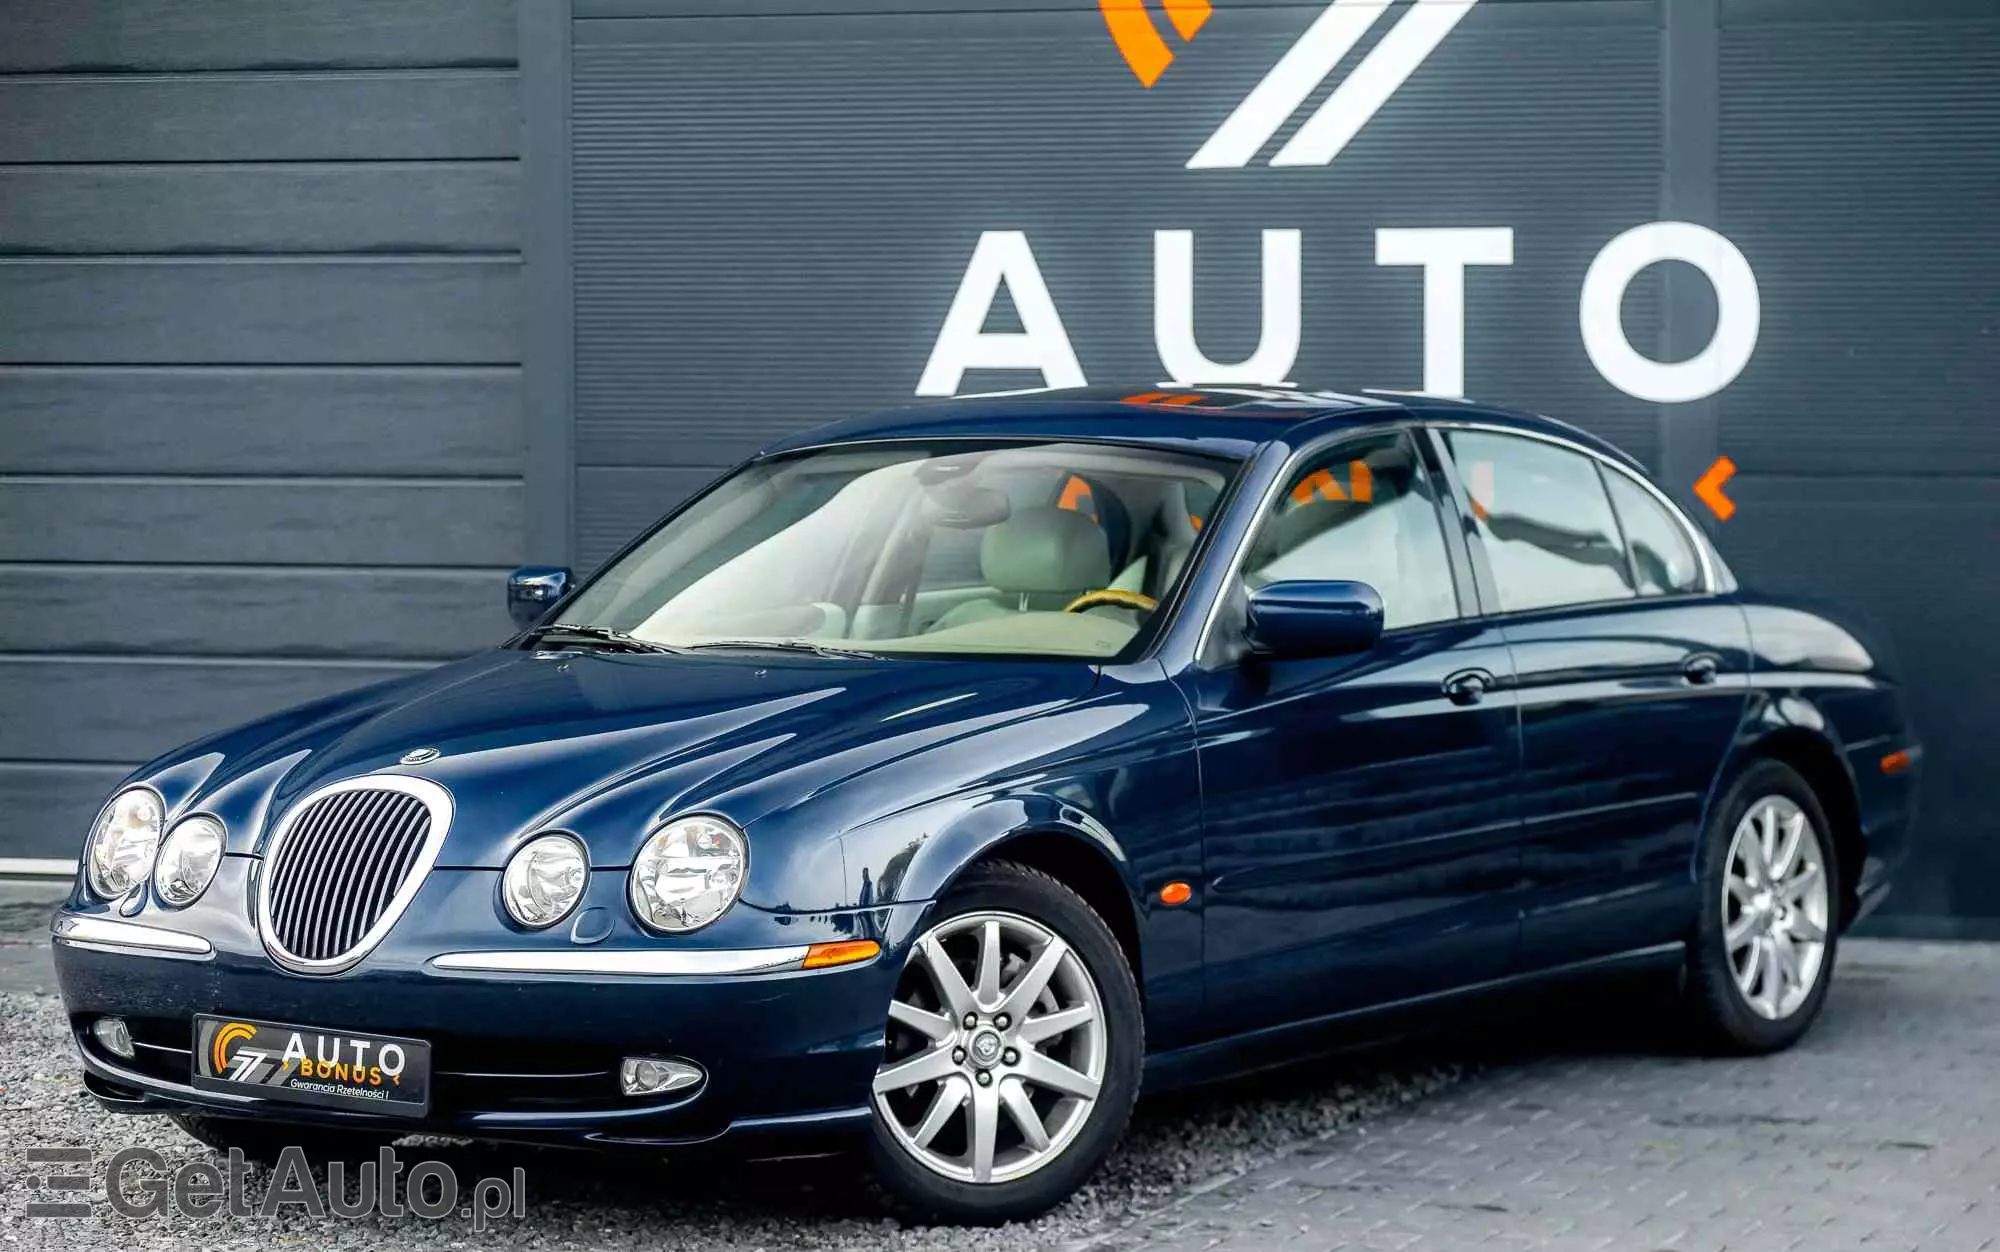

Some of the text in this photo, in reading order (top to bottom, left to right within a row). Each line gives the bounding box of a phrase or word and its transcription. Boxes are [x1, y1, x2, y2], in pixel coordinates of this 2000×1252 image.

[915, 220, 1761, 402] AUTO
[282, 1032, 406, 1077] AUTO
[301, 1057, 382, 1086] BONUS
